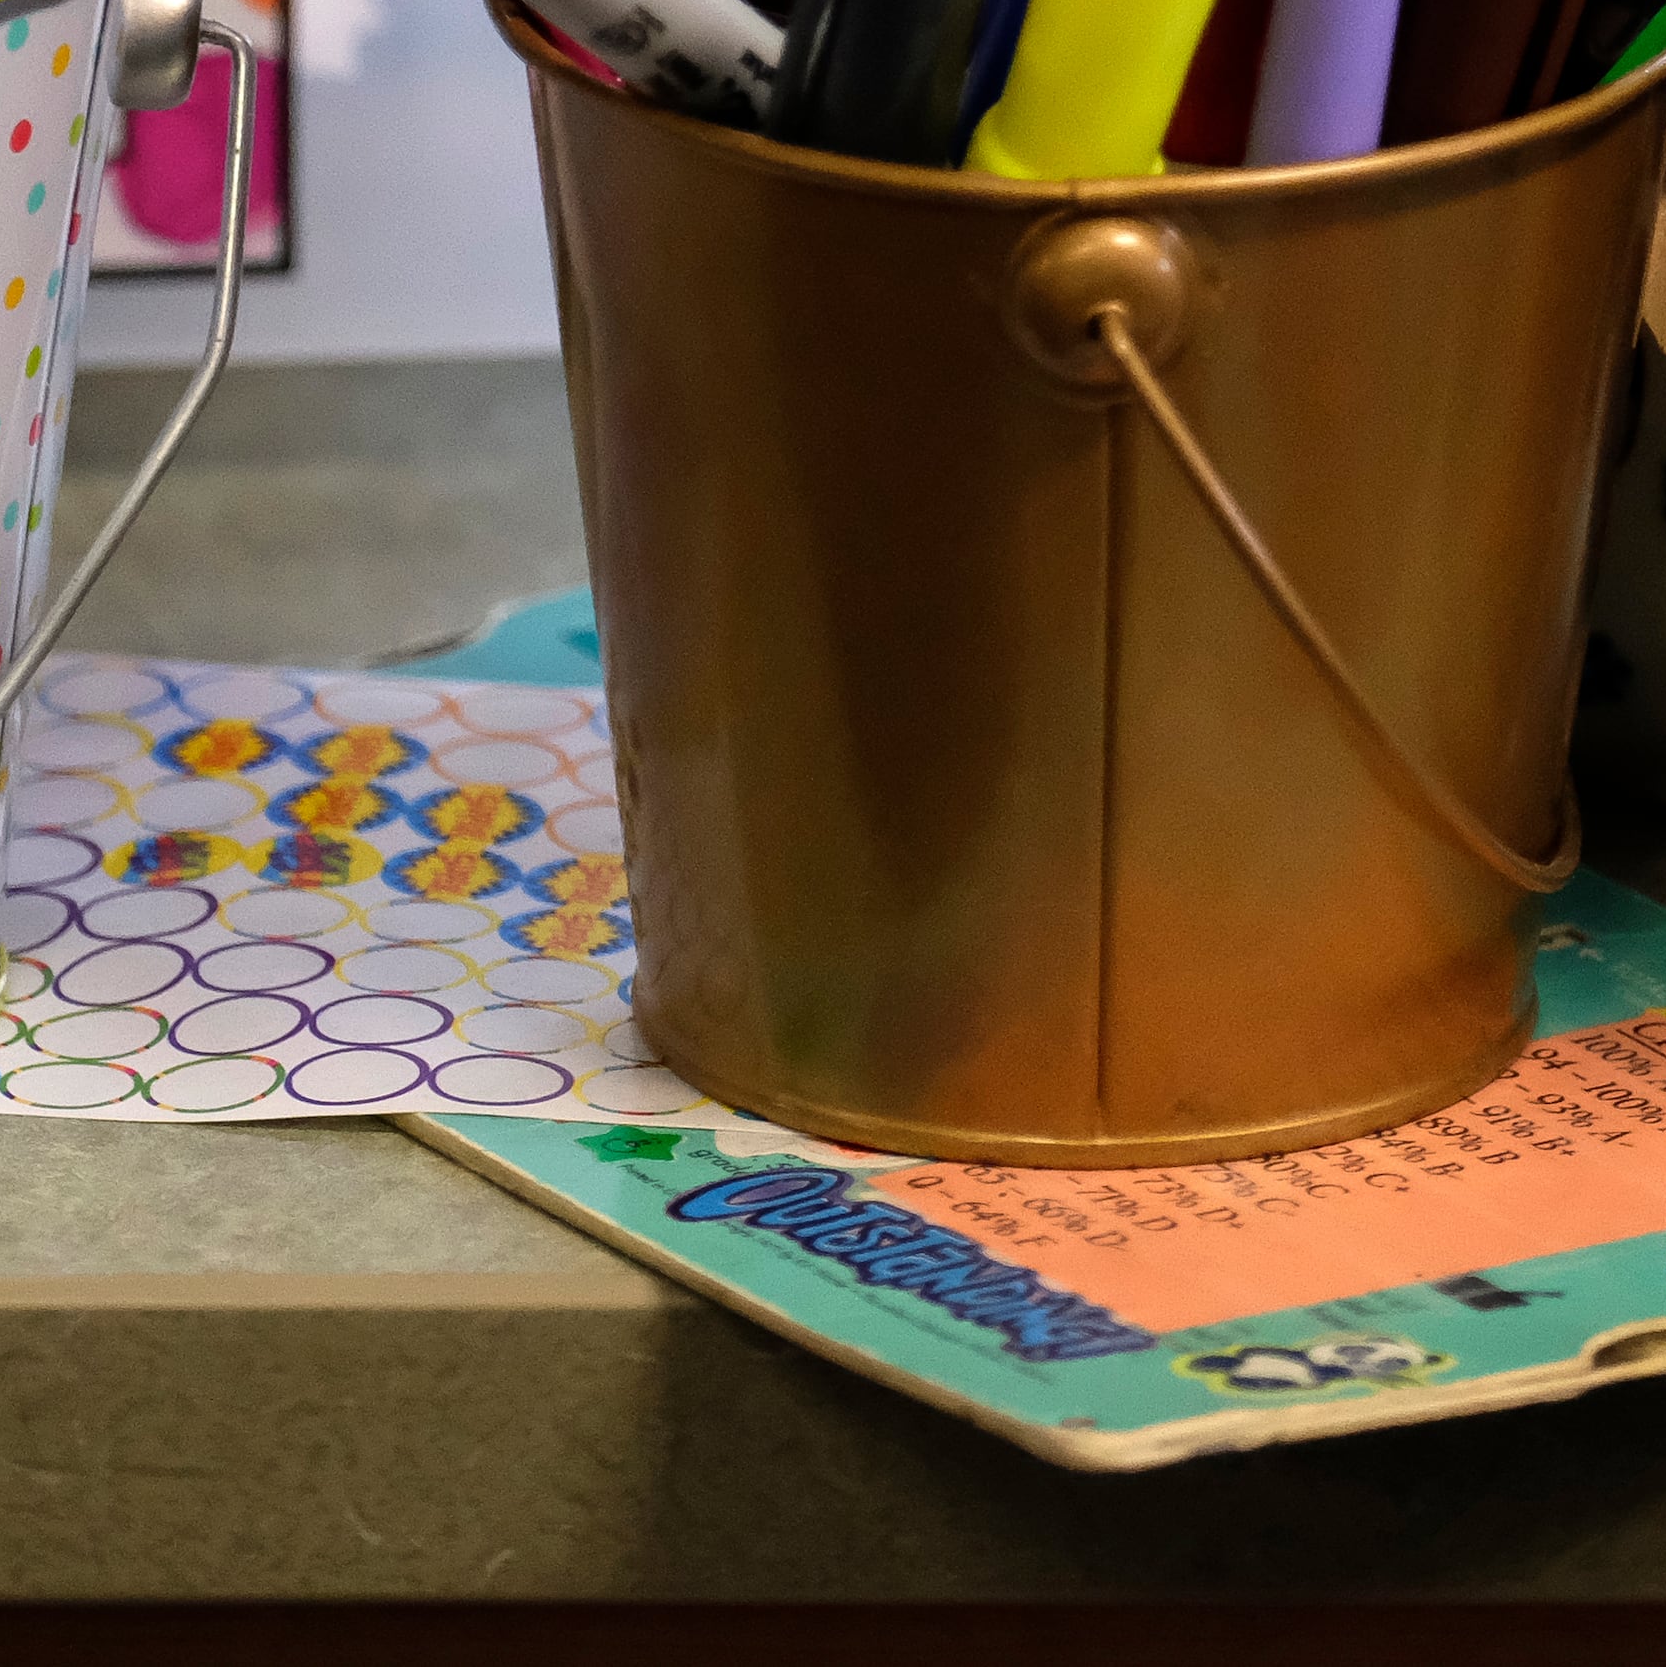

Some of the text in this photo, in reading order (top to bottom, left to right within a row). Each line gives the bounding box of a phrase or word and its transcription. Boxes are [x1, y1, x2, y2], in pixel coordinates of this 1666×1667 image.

[1520, 1047, 1577, 1071] 94
[1570, 1033, 1661, 1077] 100%
[1471, 1103, 1577, 1157] 91% B+
[1526, 1093, 1603, 1129] 93%
[1312, 1145, 1375, 1174] 2%
[1415, 1116, 1522, 1166] 89% B
